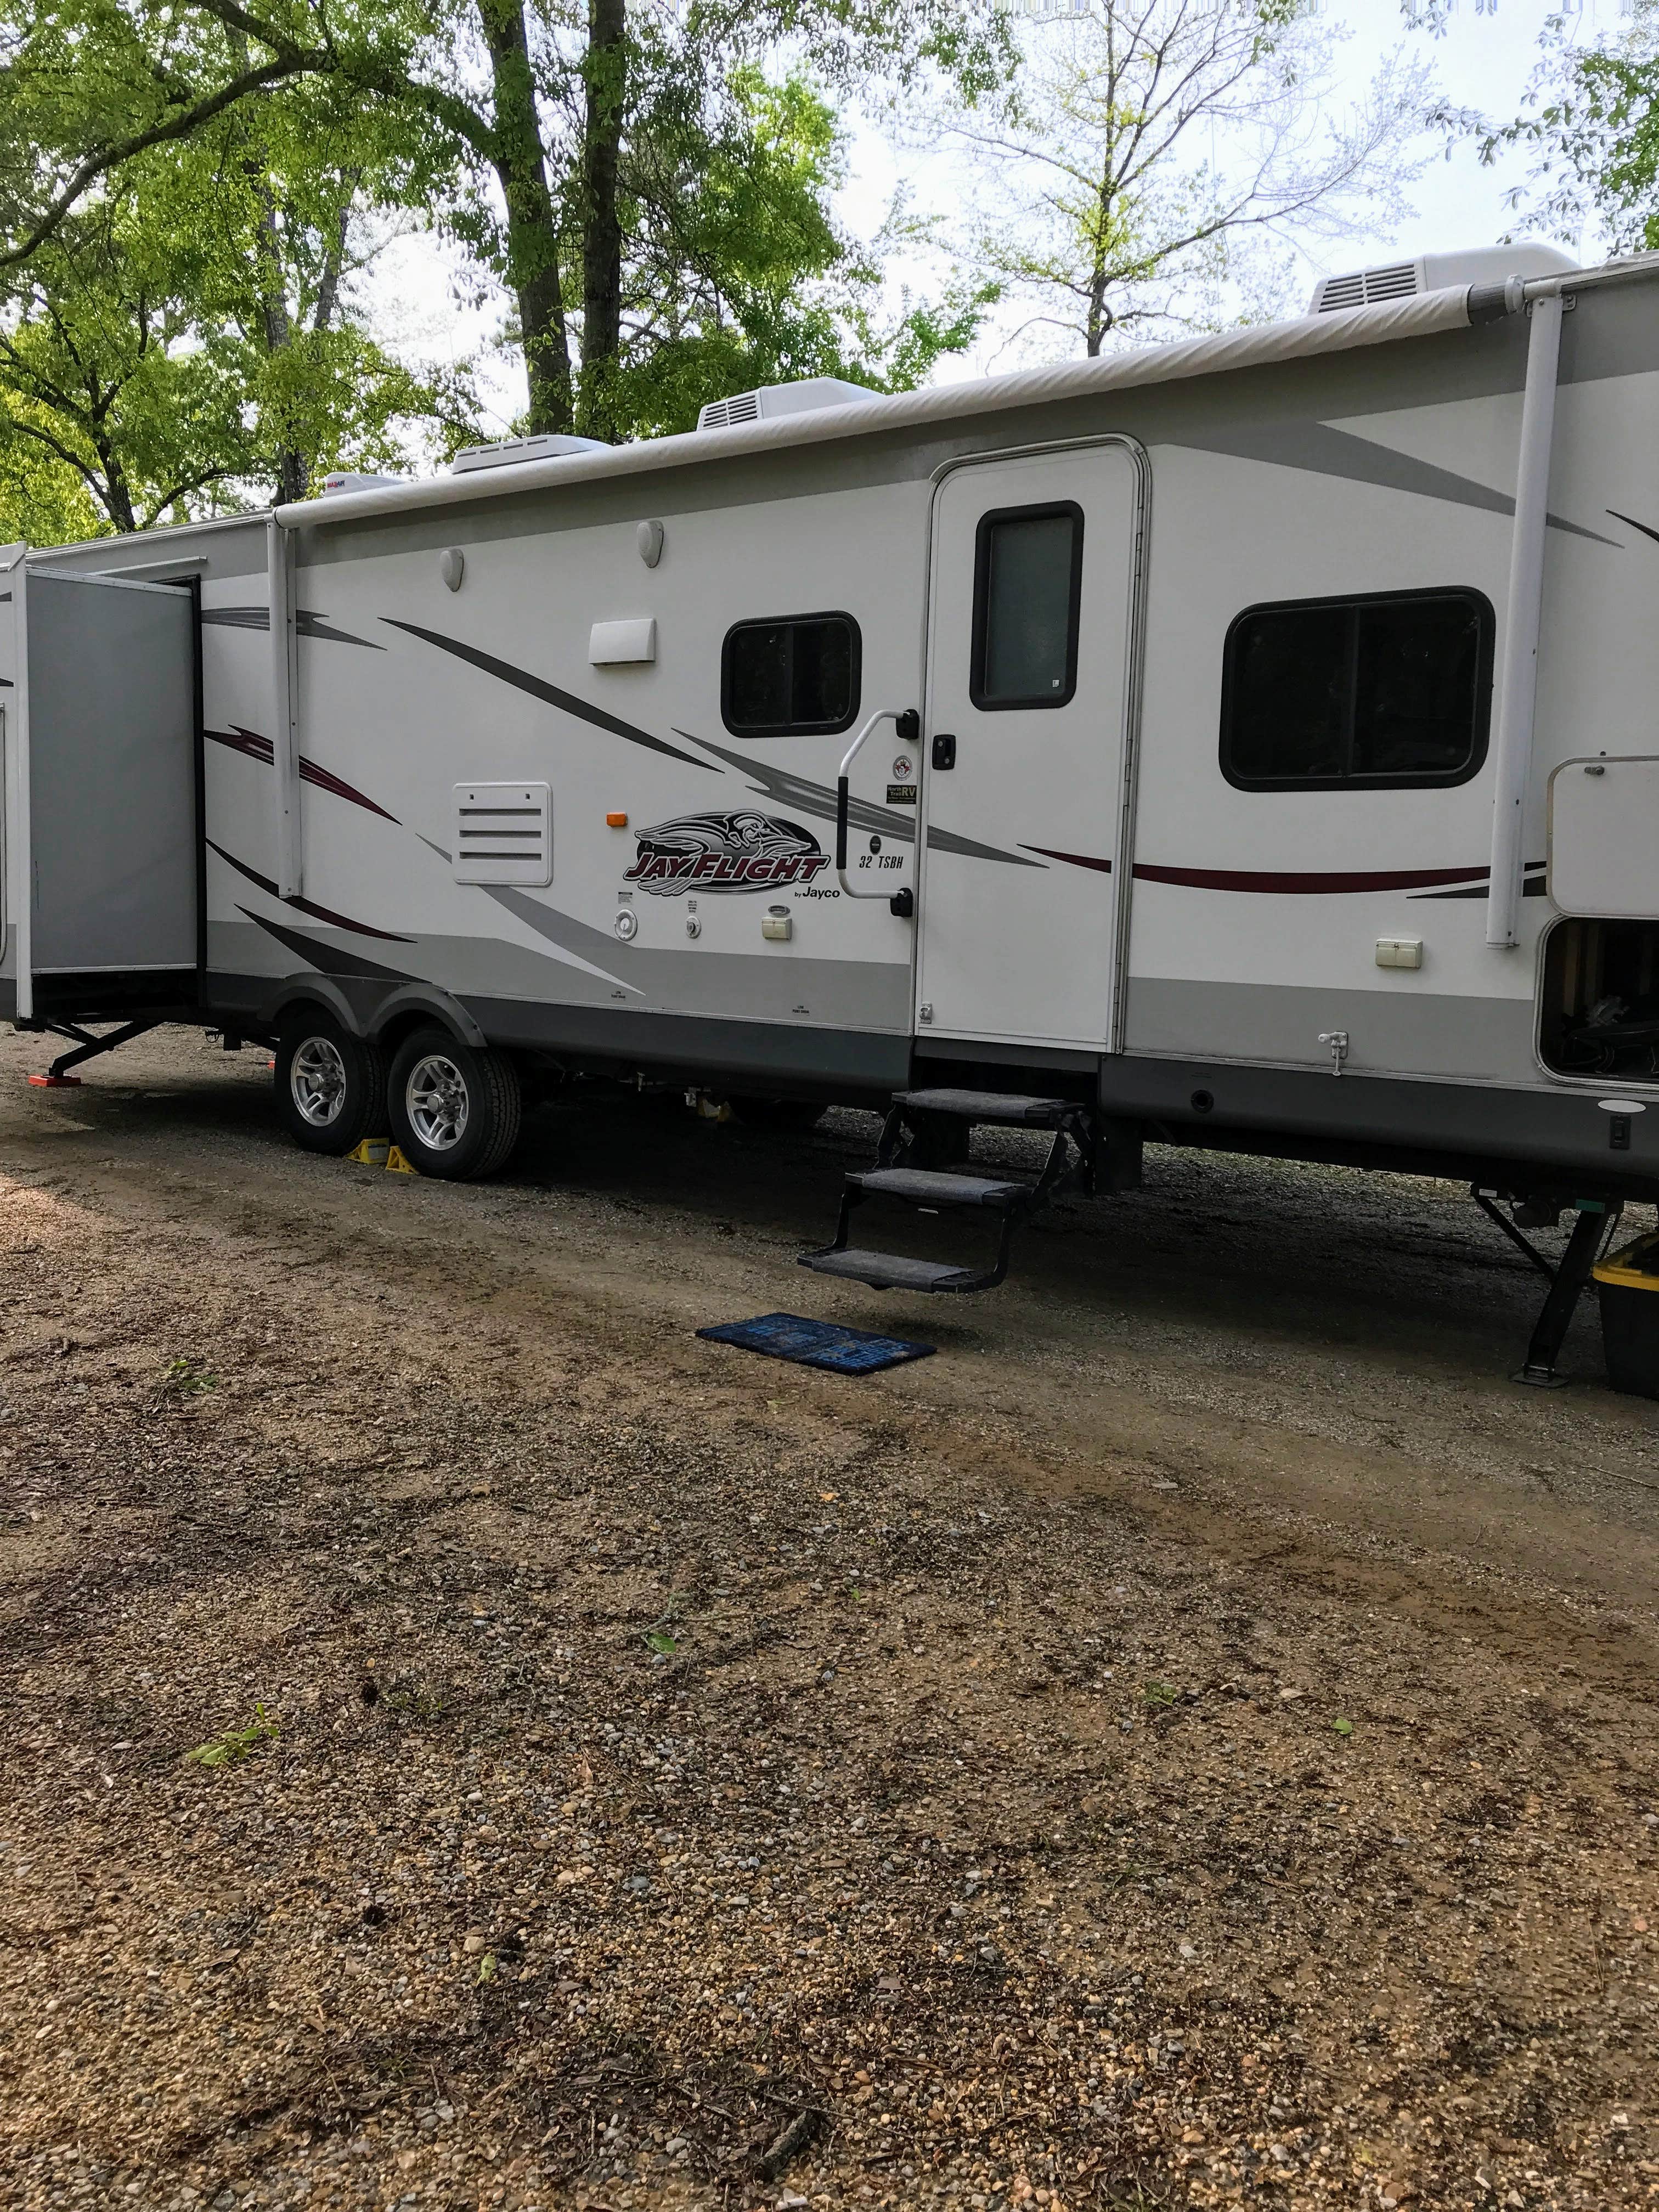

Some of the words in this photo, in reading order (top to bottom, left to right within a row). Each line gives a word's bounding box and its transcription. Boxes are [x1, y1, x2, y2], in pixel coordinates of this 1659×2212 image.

[902, 787, 916, 797] RV
[859, 855, 873, 868] 32
[878, 856, 904, 869] TSBH
[802, 886, 840, 900] Jayco
